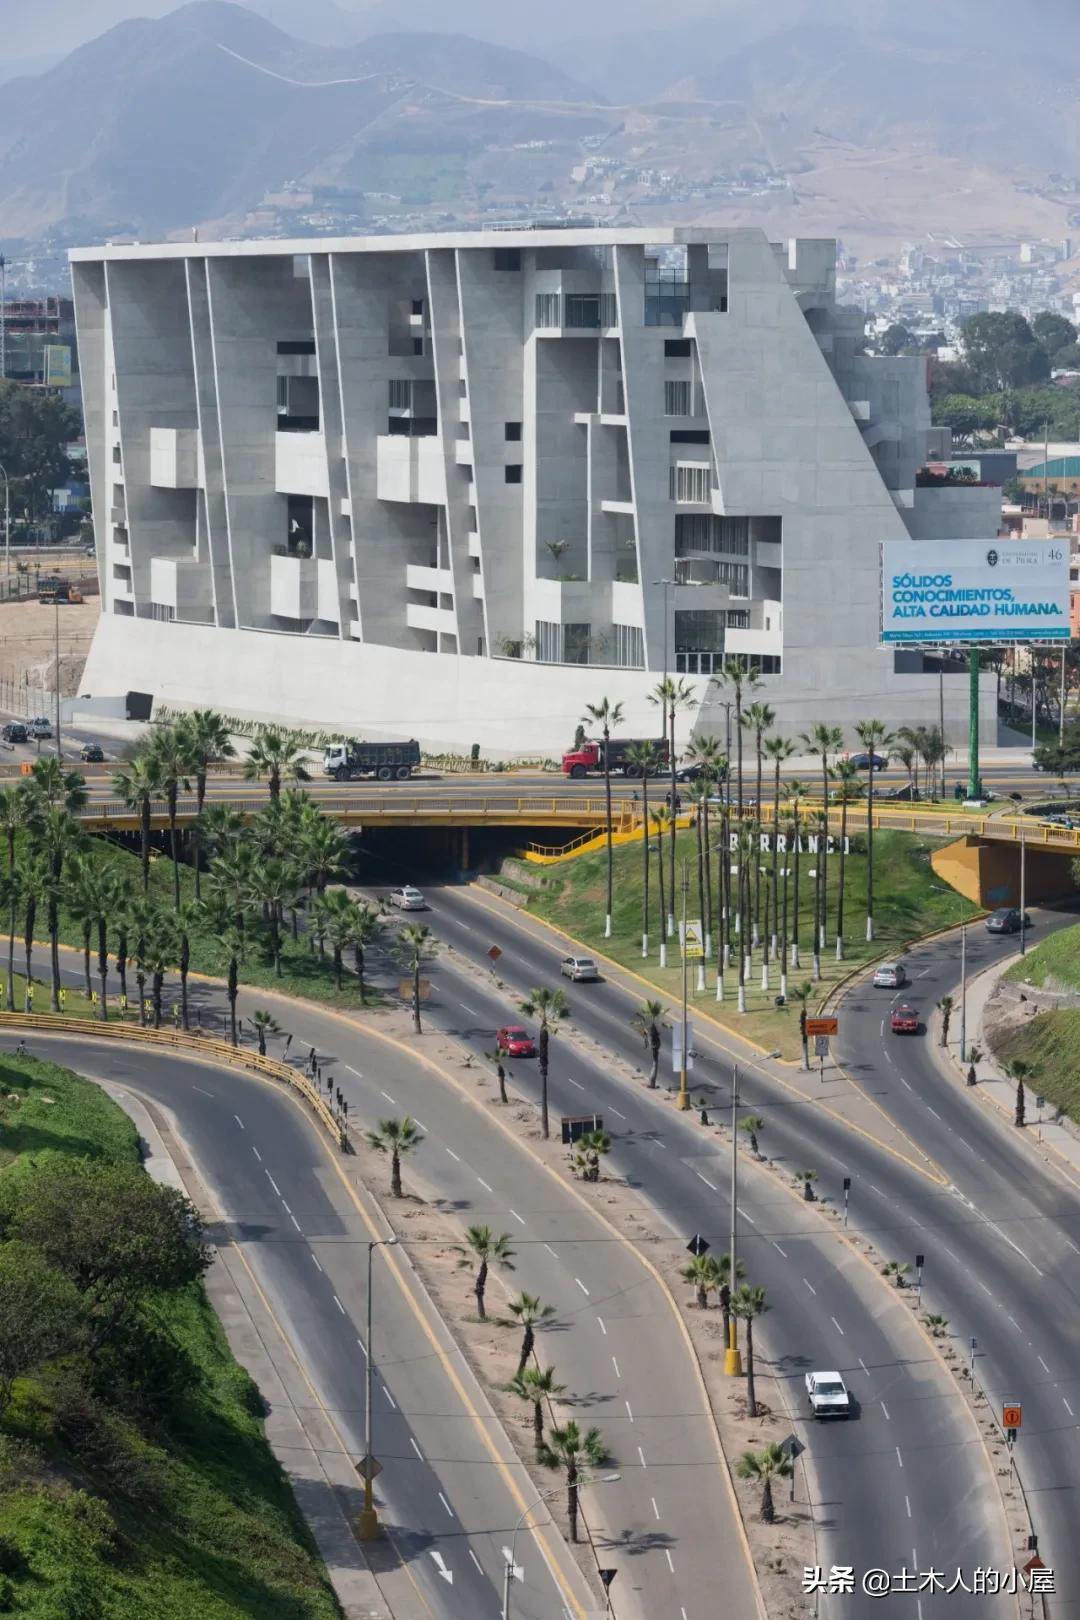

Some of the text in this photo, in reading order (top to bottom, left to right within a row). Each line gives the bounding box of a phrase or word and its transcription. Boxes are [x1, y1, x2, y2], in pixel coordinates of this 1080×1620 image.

[1048, 549, 1062, 560] 46
[892, 573, 952, 588] SÓLIDOS
[892, 589, 1015, 603] CONOCIMIENTOS,
[892, 603, 1063, 618] ALTA CALIDAD HUMANA.
[729, 833, 849, 855] BRRANC
